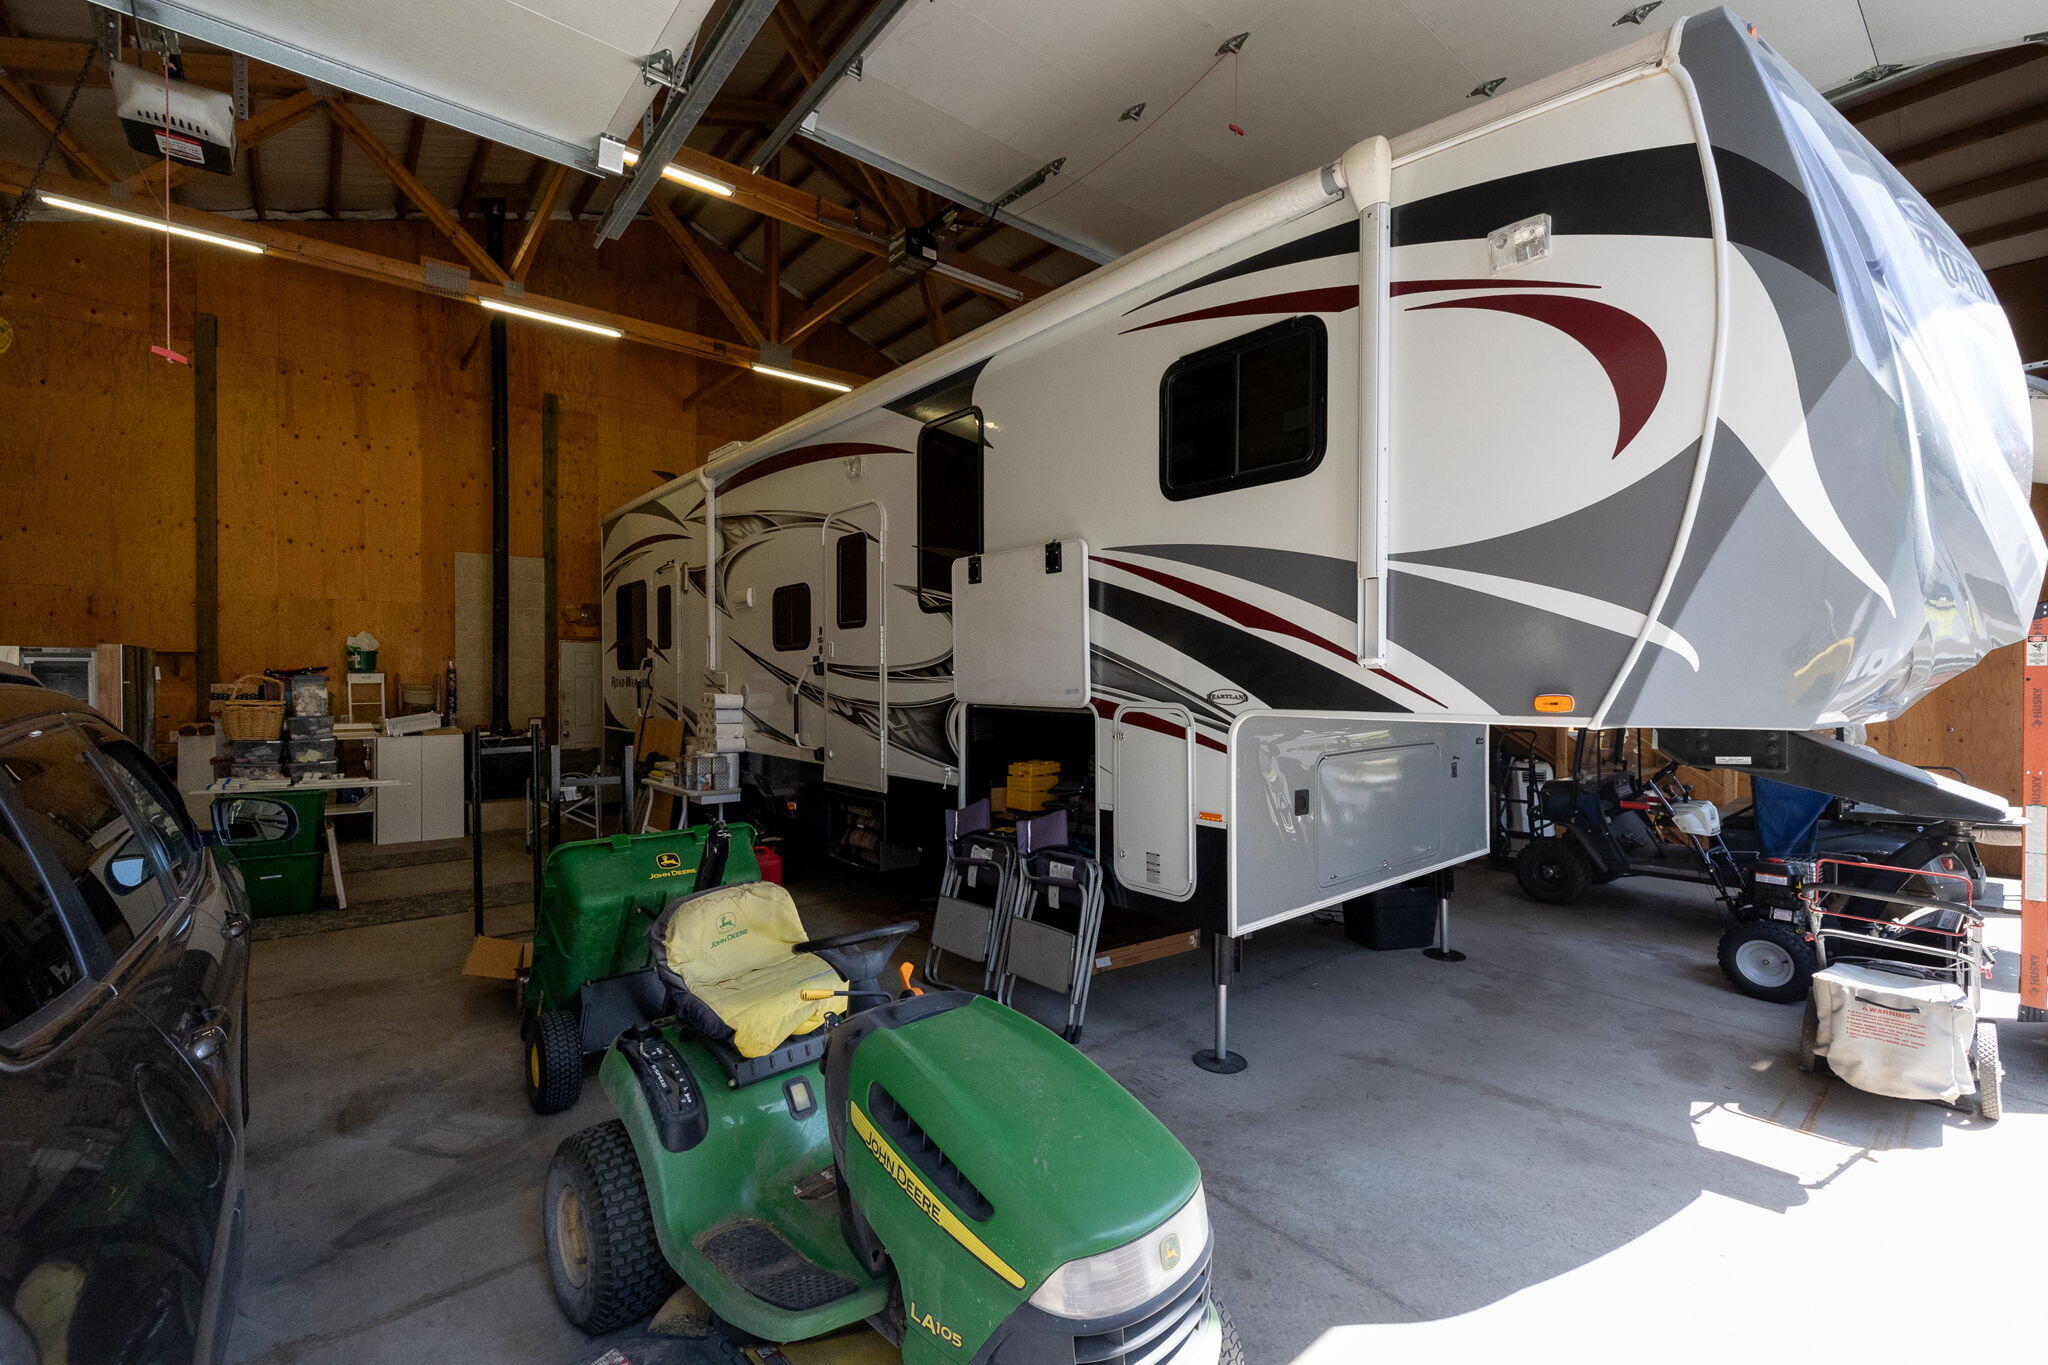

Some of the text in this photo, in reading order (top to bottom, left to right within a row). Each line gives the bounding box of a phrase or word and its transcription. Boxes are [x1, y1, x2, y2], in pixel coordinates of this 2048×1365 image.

[2032, 687, 2043, 719] HUSKY
[649, 868, 698, 880] JOHN DEERE
[710, 928, 749, 949] JOHN DEERE
[1869, 1006, 1912, 1020] WARNING
[865, 1131, 941, 1223] JOHN DEERE
[910, 1302, 963, 1348] LA105
